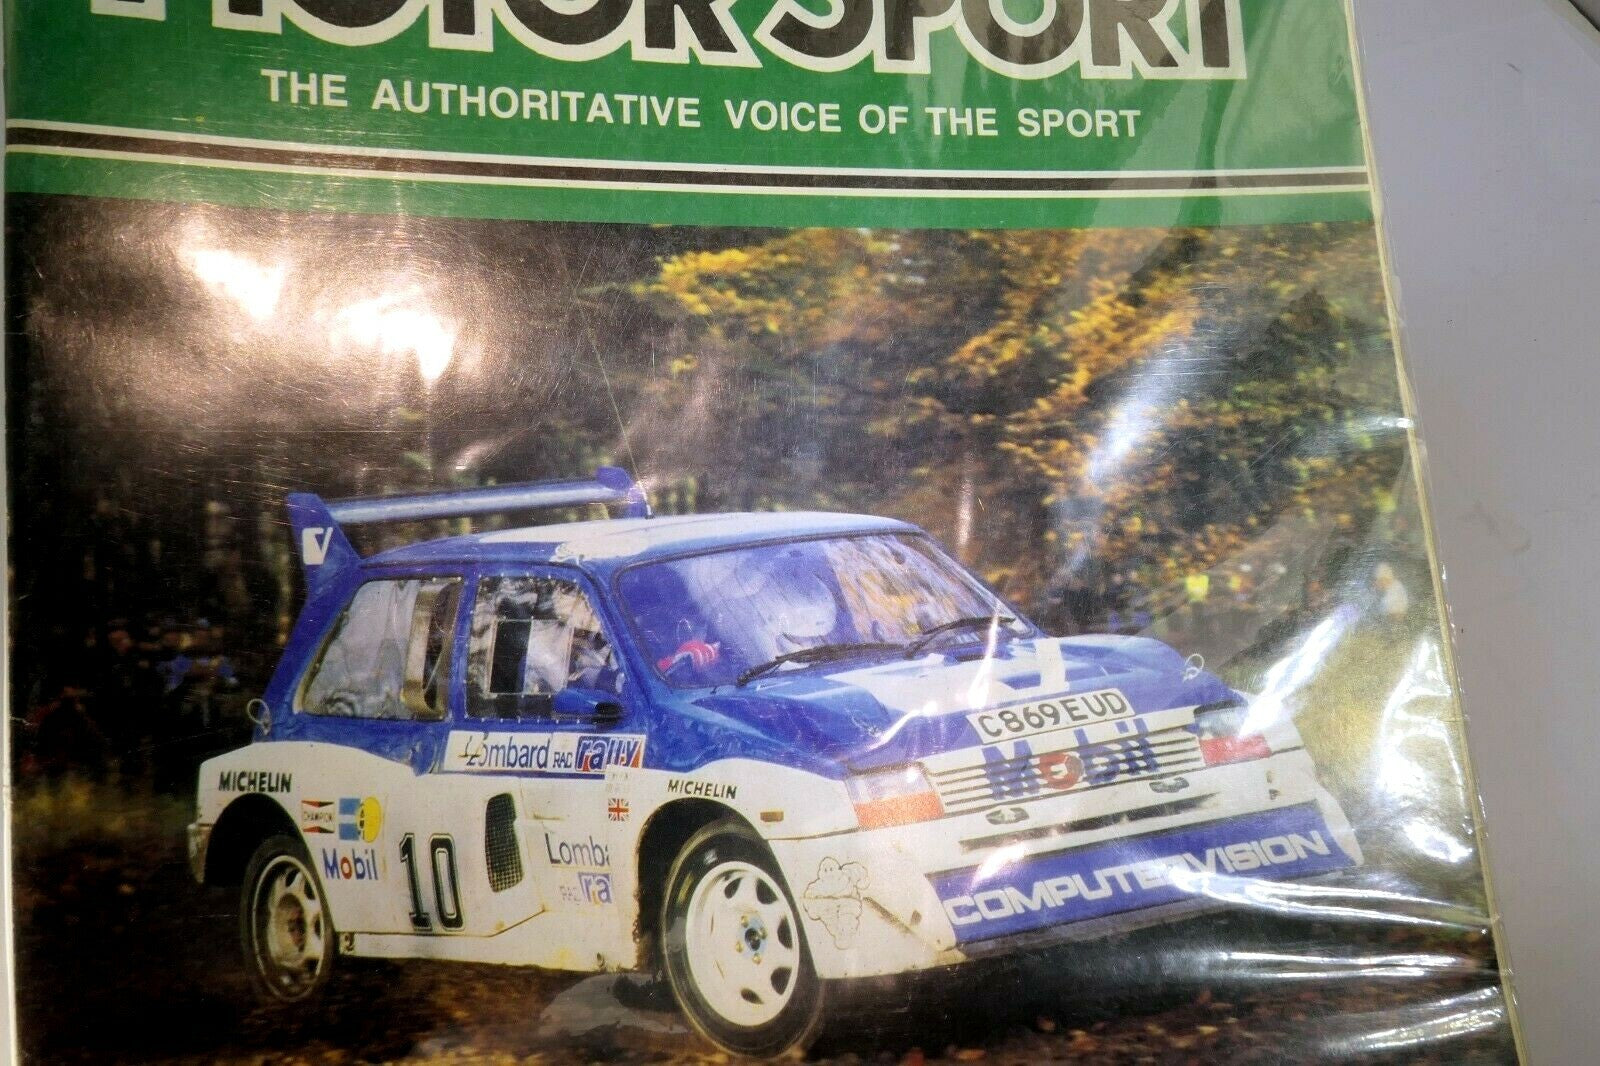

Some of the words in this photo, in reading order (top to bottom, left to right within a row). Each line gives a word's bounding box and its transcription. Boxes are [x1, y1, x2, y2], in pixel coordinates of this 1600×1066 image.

[260, 68, 348, 108] THE
[372, 78, 701, 129] AUTHORITATIVE
[724, 98, 842, 134] VOICE
[858, 104, 909, 136] OF
[925, 106, 999, 137] THE
[1017, 108, 1142, 138] SPORT
[553, 751, 573, 769] RAC
[981, 717, 1160, 801] Mobil
[218, 770, 292, 793] MICHELIN
[667, 779, 738, 800] MICHELIN
[322, 847, 379, 881] Mobil
[399, 832, 466, 932] 10
